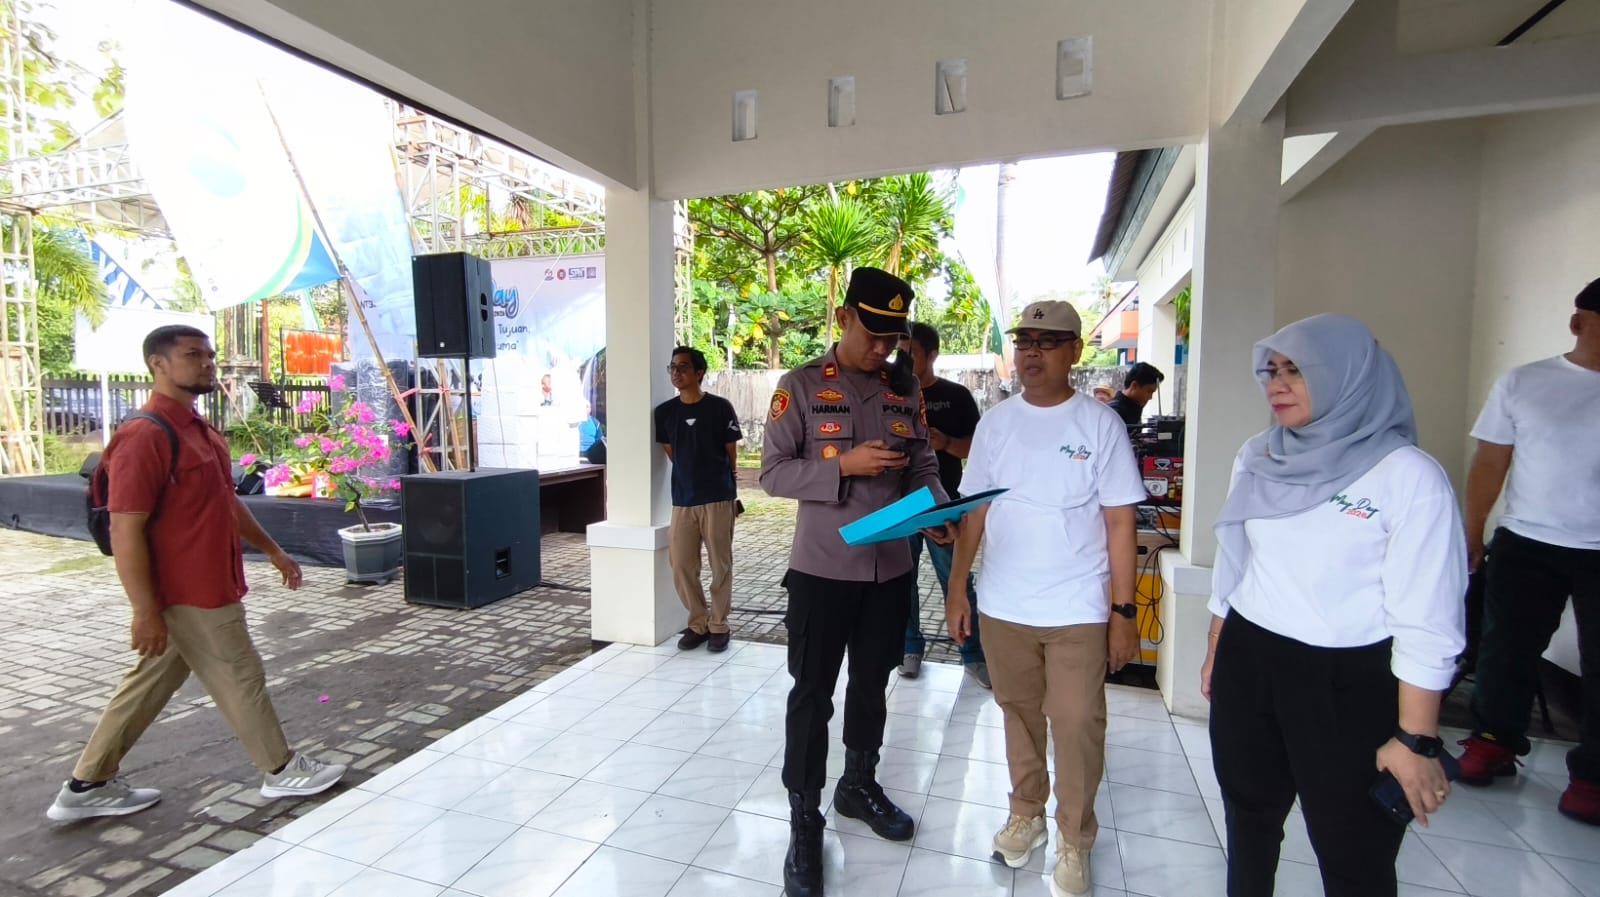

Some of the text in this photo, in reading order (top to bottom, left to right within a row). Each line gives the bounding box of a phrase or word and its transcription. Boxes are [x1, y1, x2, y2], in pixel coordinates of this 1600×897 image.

[493, 280, 519, 319] ay
[812, 404, 850, 414] HARMAN
[882, 404, 914, 416] POLRI
[927, 400, 951, 411] light
[1060, 444, 1075, 459] May
[1078, 444, 1092, 461] Day
[1329, 494, 1380, 519] May Day
